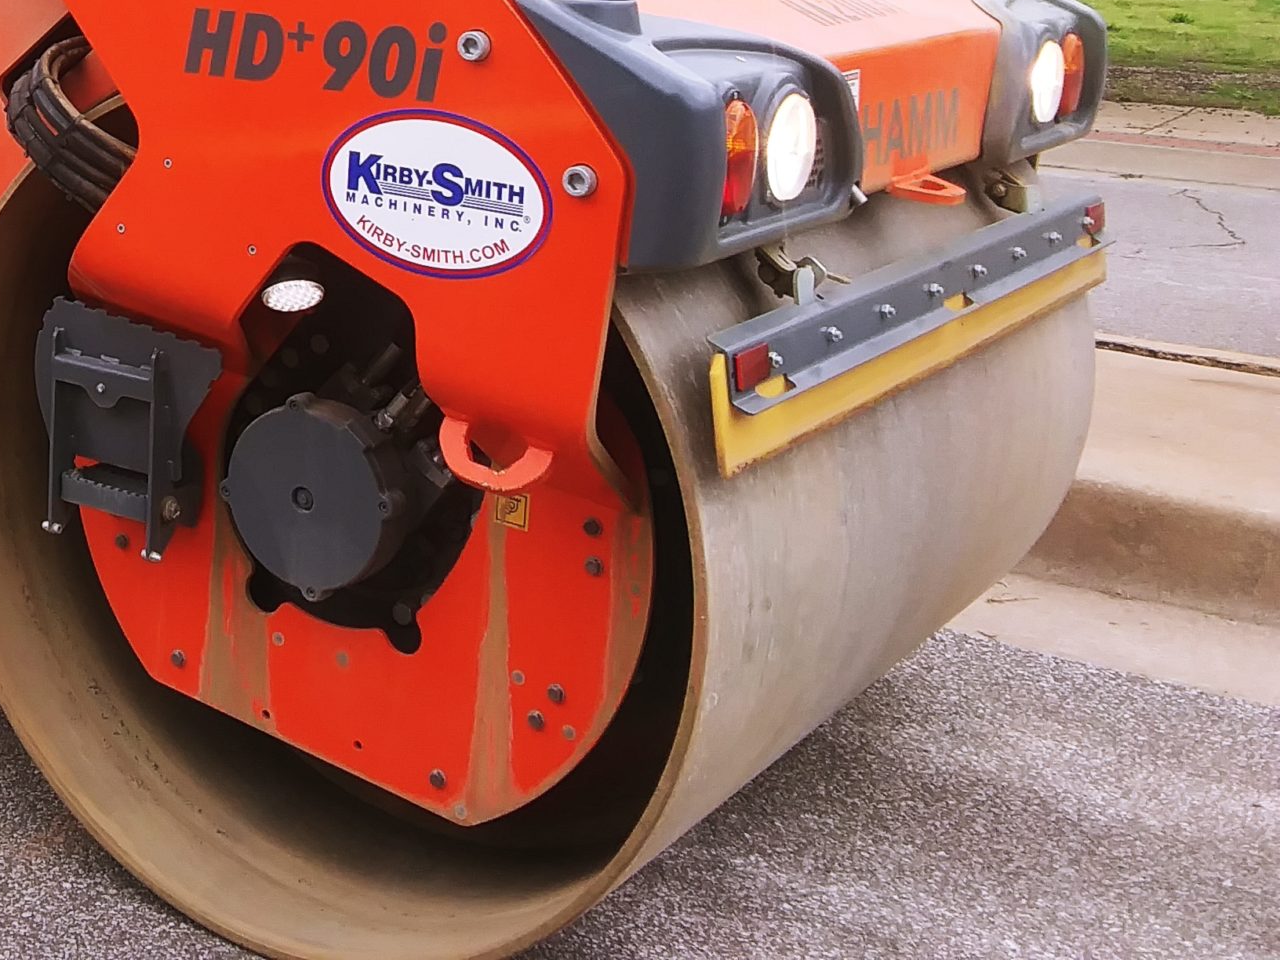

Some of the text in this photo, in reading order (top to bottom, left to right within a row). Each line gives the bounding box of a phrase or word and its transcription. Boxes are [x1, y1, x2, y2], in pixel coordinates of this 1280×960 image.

[862, 87, 960, 166] HAMM
[346, 150, 525, 206] KIRBY-SMITH
[346, 191, 523, 233] MACHINERY, INC.
[357, 214, 511, 265] KIRBY-SMITH.COM
